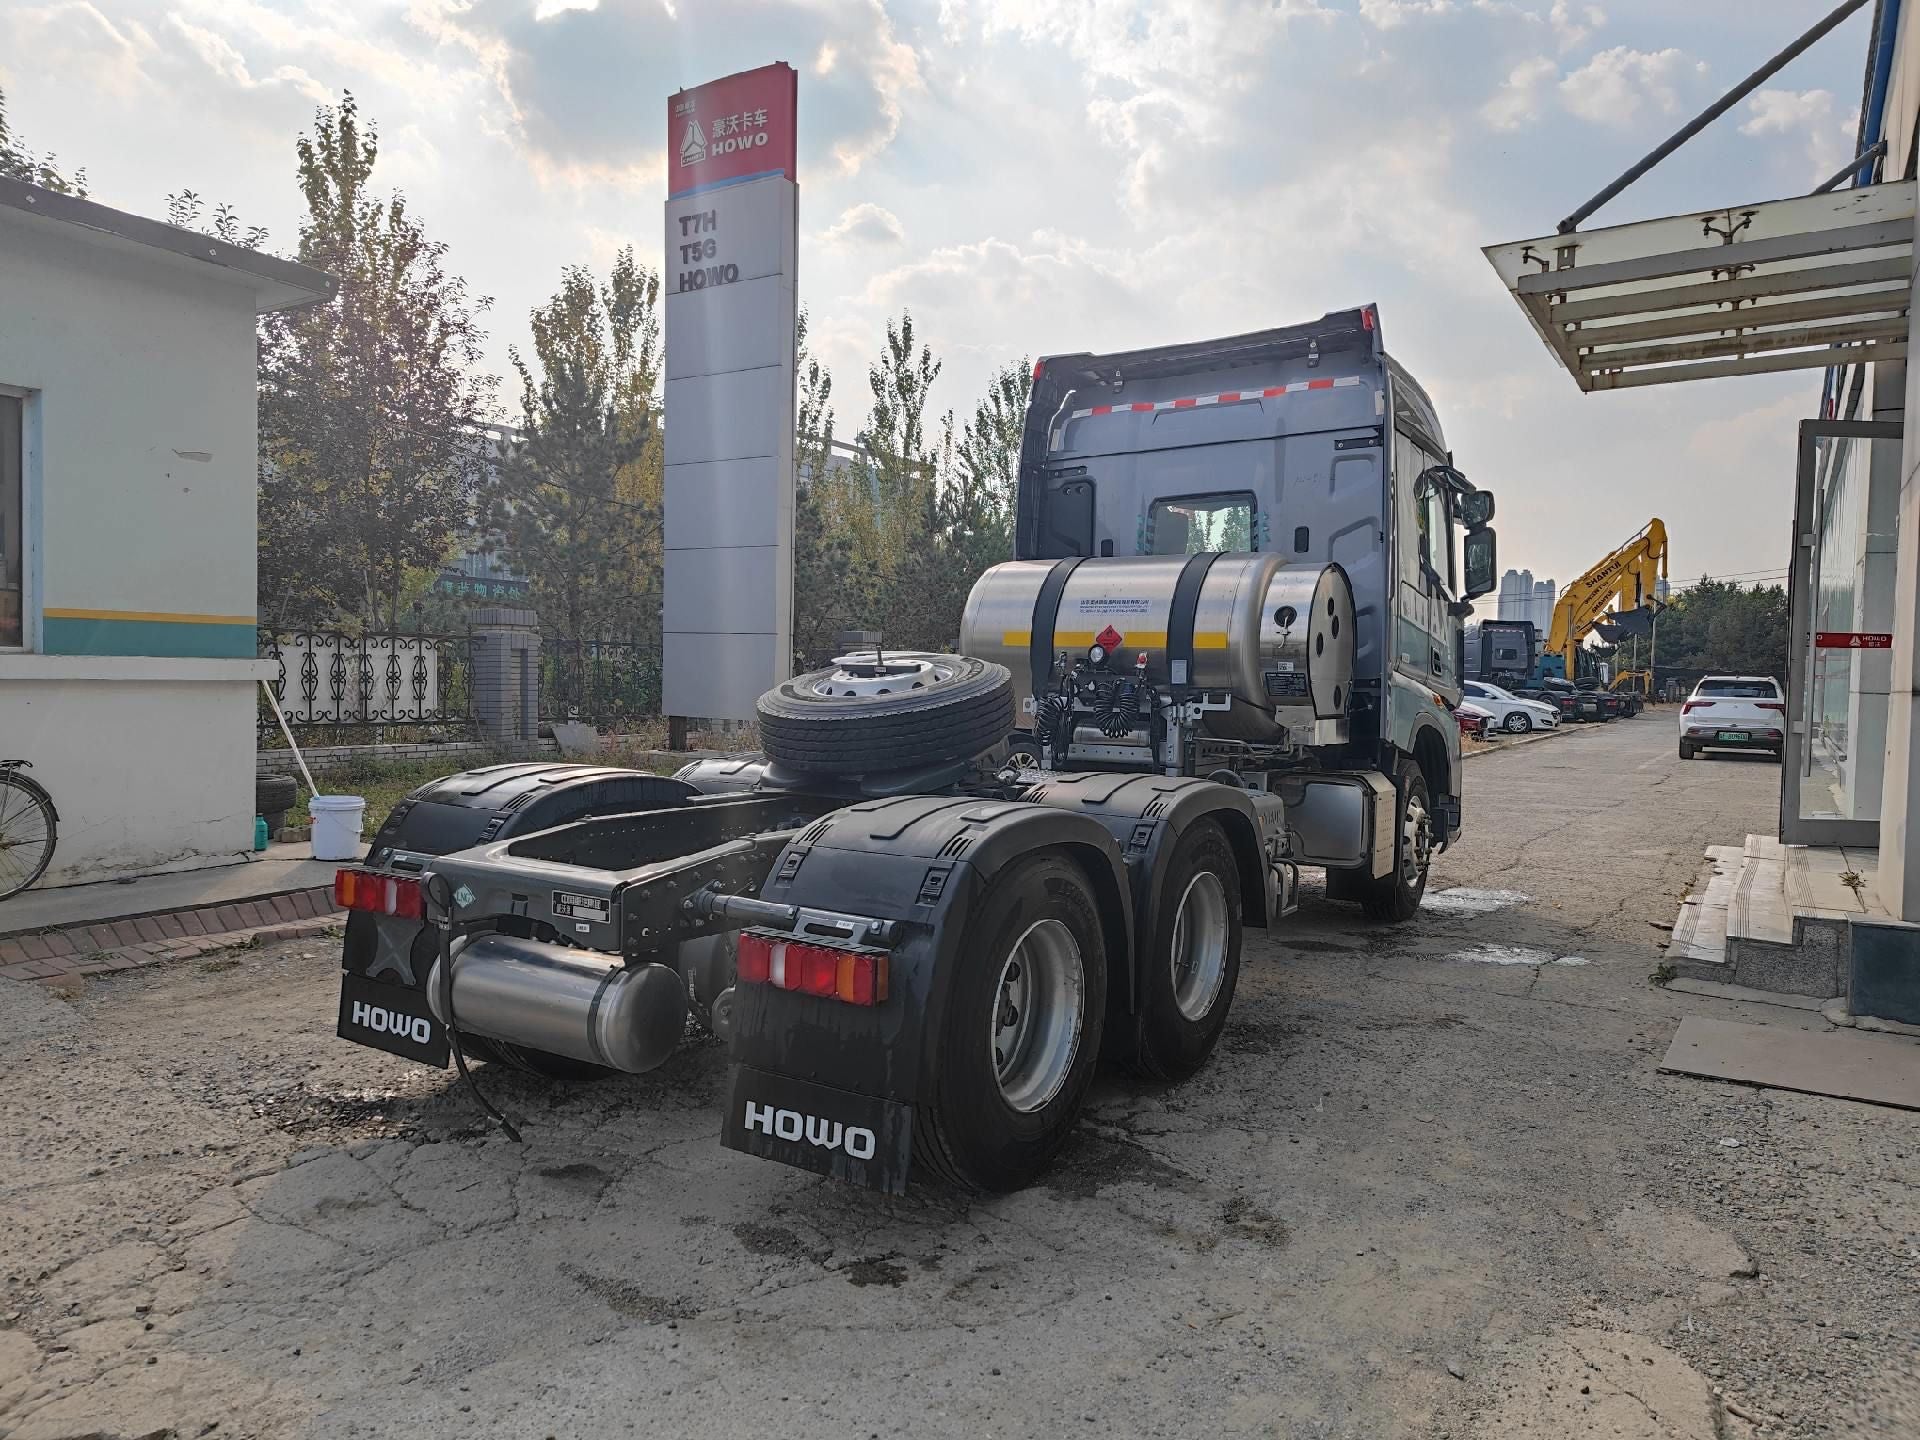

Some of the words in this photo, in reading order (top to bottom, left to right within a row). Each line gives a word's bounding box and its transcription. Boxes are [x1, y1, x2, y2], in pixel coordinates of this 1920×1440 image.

[712, 109, 768, 138] 豪沃卡车
[711, 132, 768, 156] HOWO
[679, 209, 717, 237] T7H
[679, 238, 717, 265] T5G
[679, 263, 739, 293] HOWO
[1585, 560, 1622, 588] SHANTUI
[455, 890, 471, 902] LNG
[351, 999, 431, 1045] HOWO
[744, 1100, 876, 1161] HOWO
